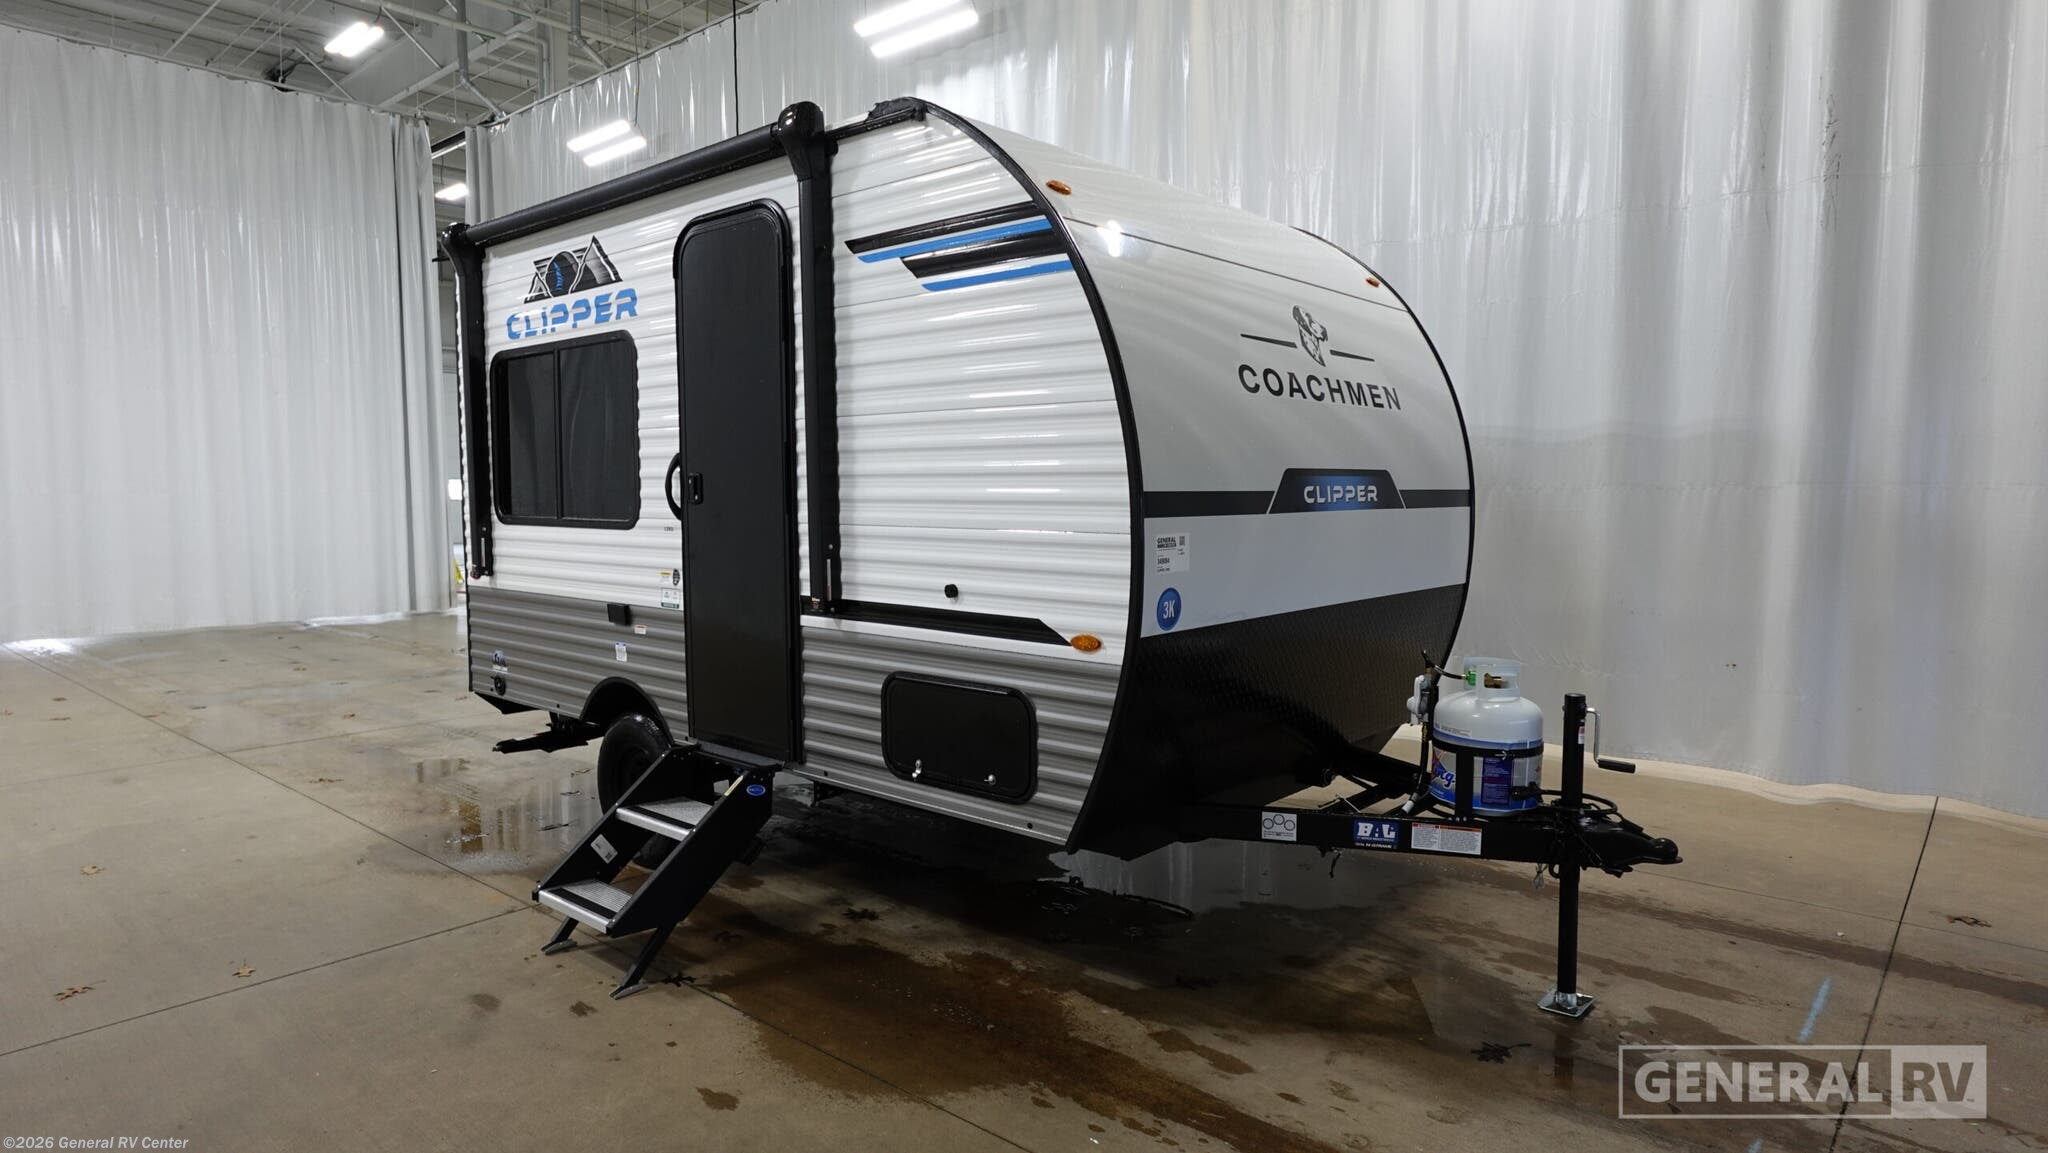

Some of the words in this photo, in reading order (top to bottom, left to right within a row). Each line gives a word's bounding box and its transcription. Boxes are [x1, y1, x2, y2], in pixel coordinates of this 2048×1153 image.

[506, 287, 638, 340] CLIPPER
[1237, 364, 1402, 411] COACHMEN
[1303, 484, 1378, 504] CLIPPER
[1163, 600, 1175, 619] 3K
